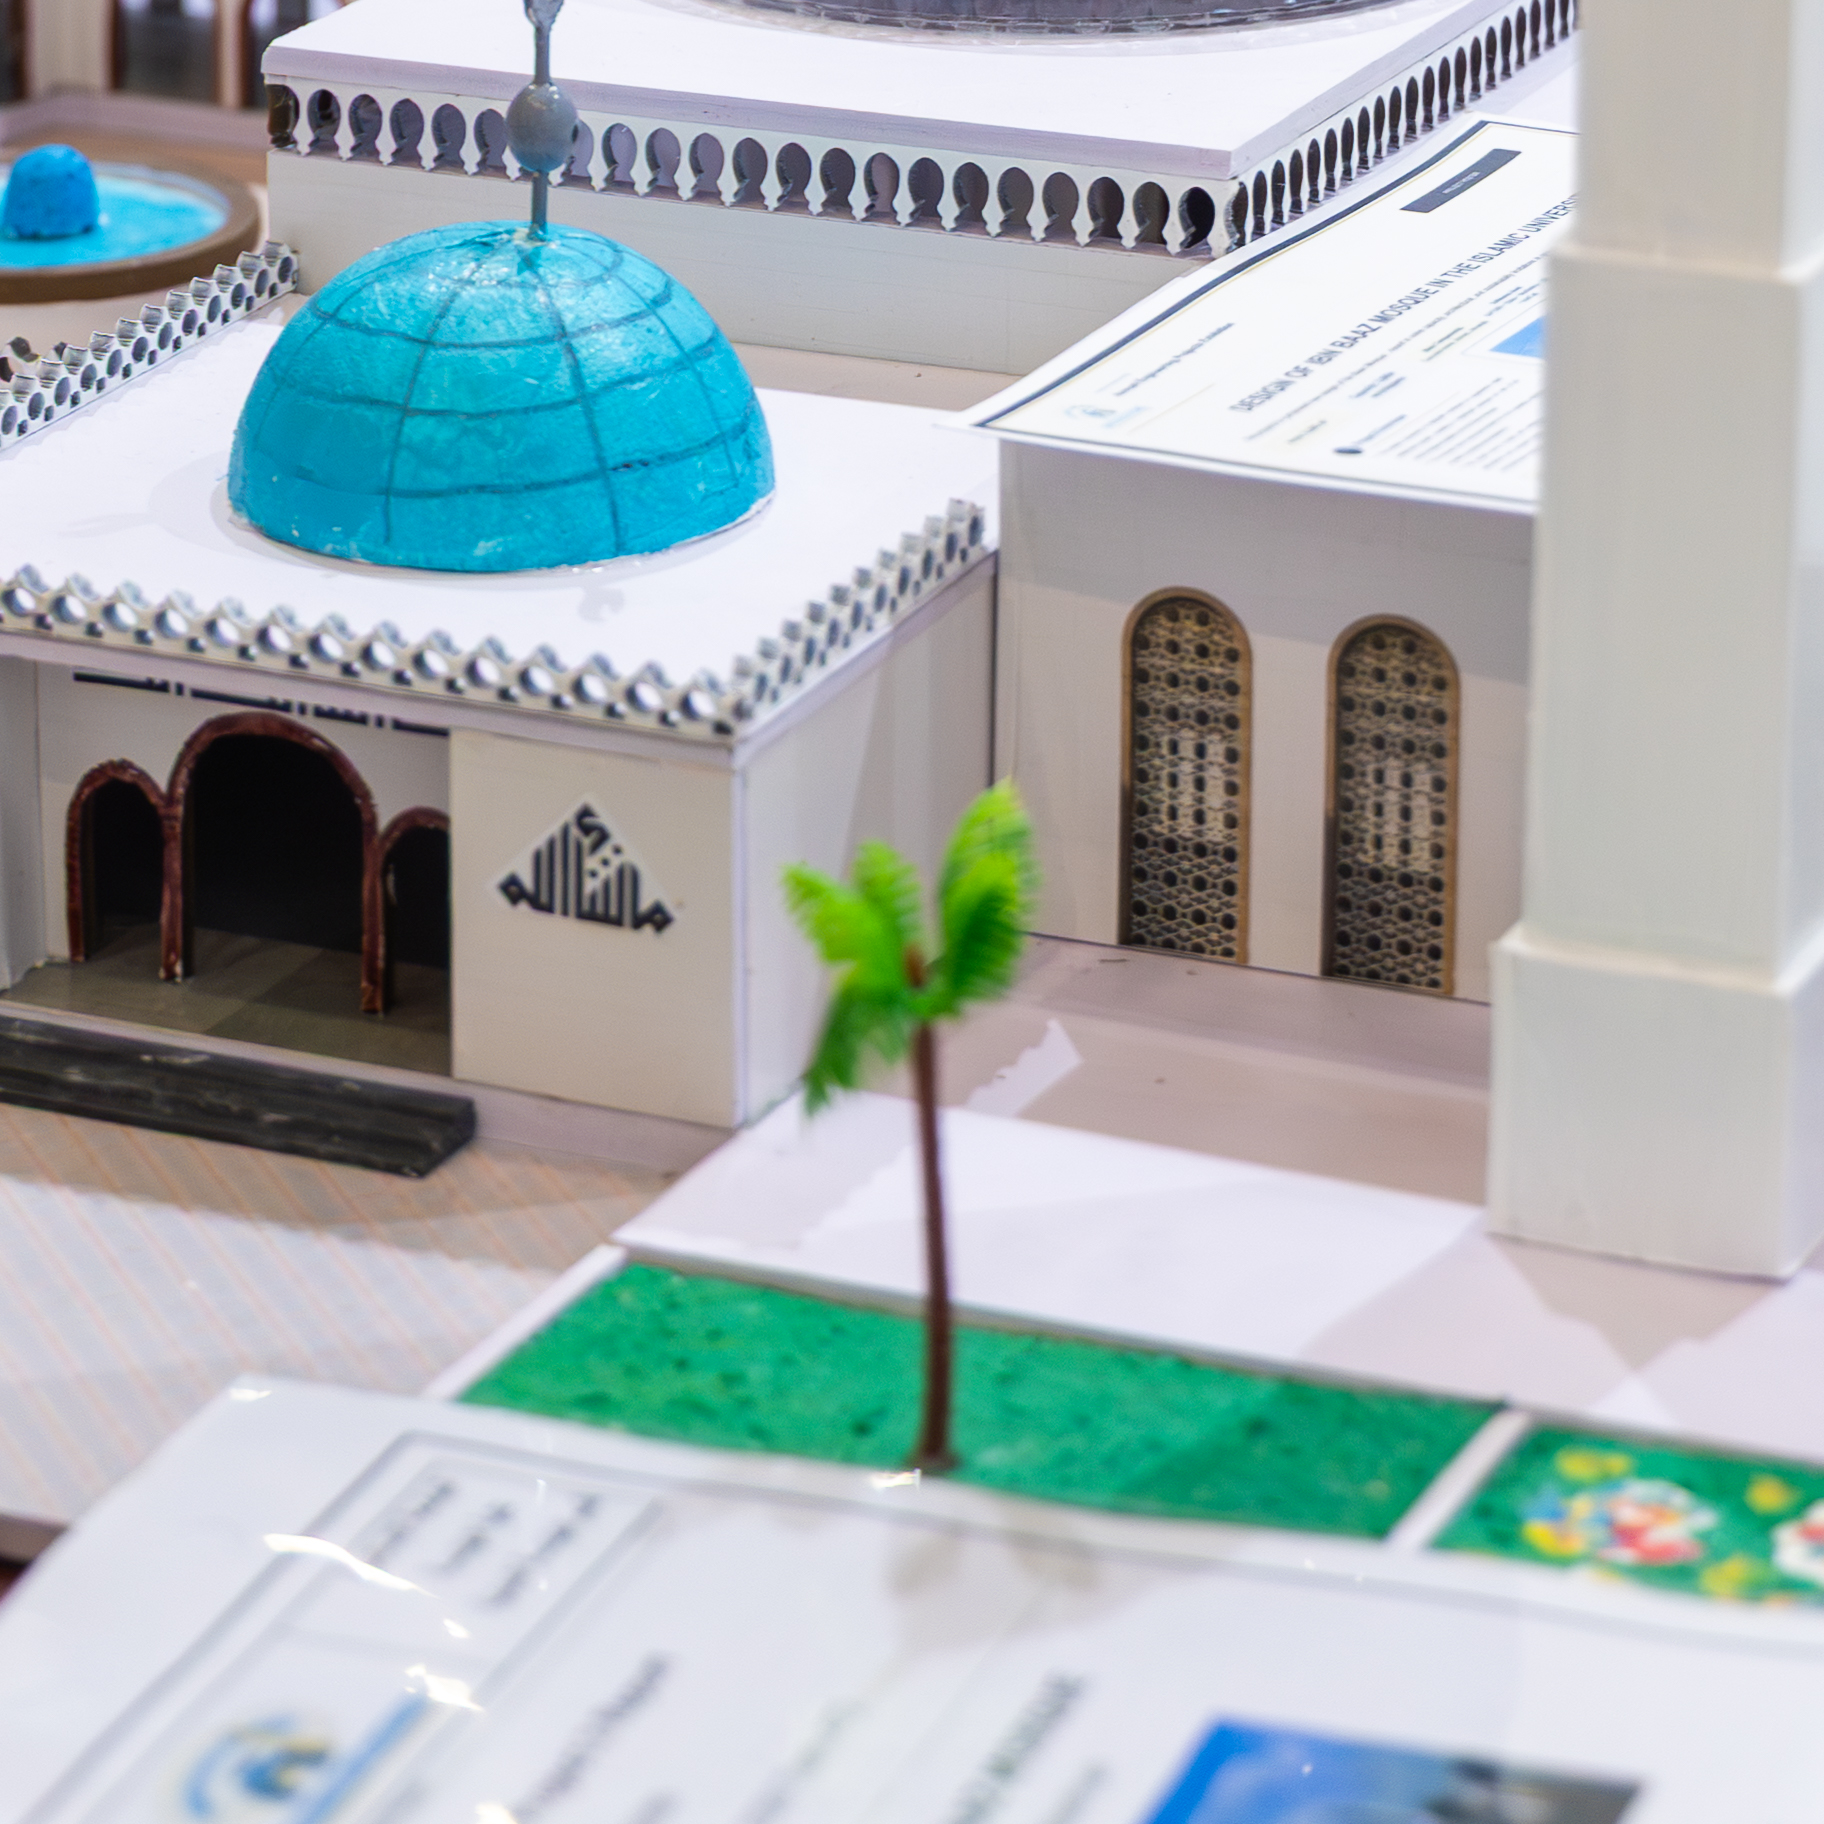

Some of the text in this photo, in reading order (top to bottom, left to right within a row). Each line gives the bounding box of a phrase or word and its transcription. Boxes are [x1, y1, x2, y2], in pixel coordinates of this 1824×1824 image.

[1229, 379, 1296, 413] DESIGN
[1284, 364, 1315, 379] OF
[1305, 347, 1344, 366] IBN
[1329, 323, 1383, 349] BAAZ
[1368, 286, 1440, 325] MOSQUE
[1425, 277, 1455, 289] IN
[1440, 261, 1482, 279] THE
[1467, 232, 1531, 264] ISLAMIC
[1517, 194, 1578, 233] UNIVERS
